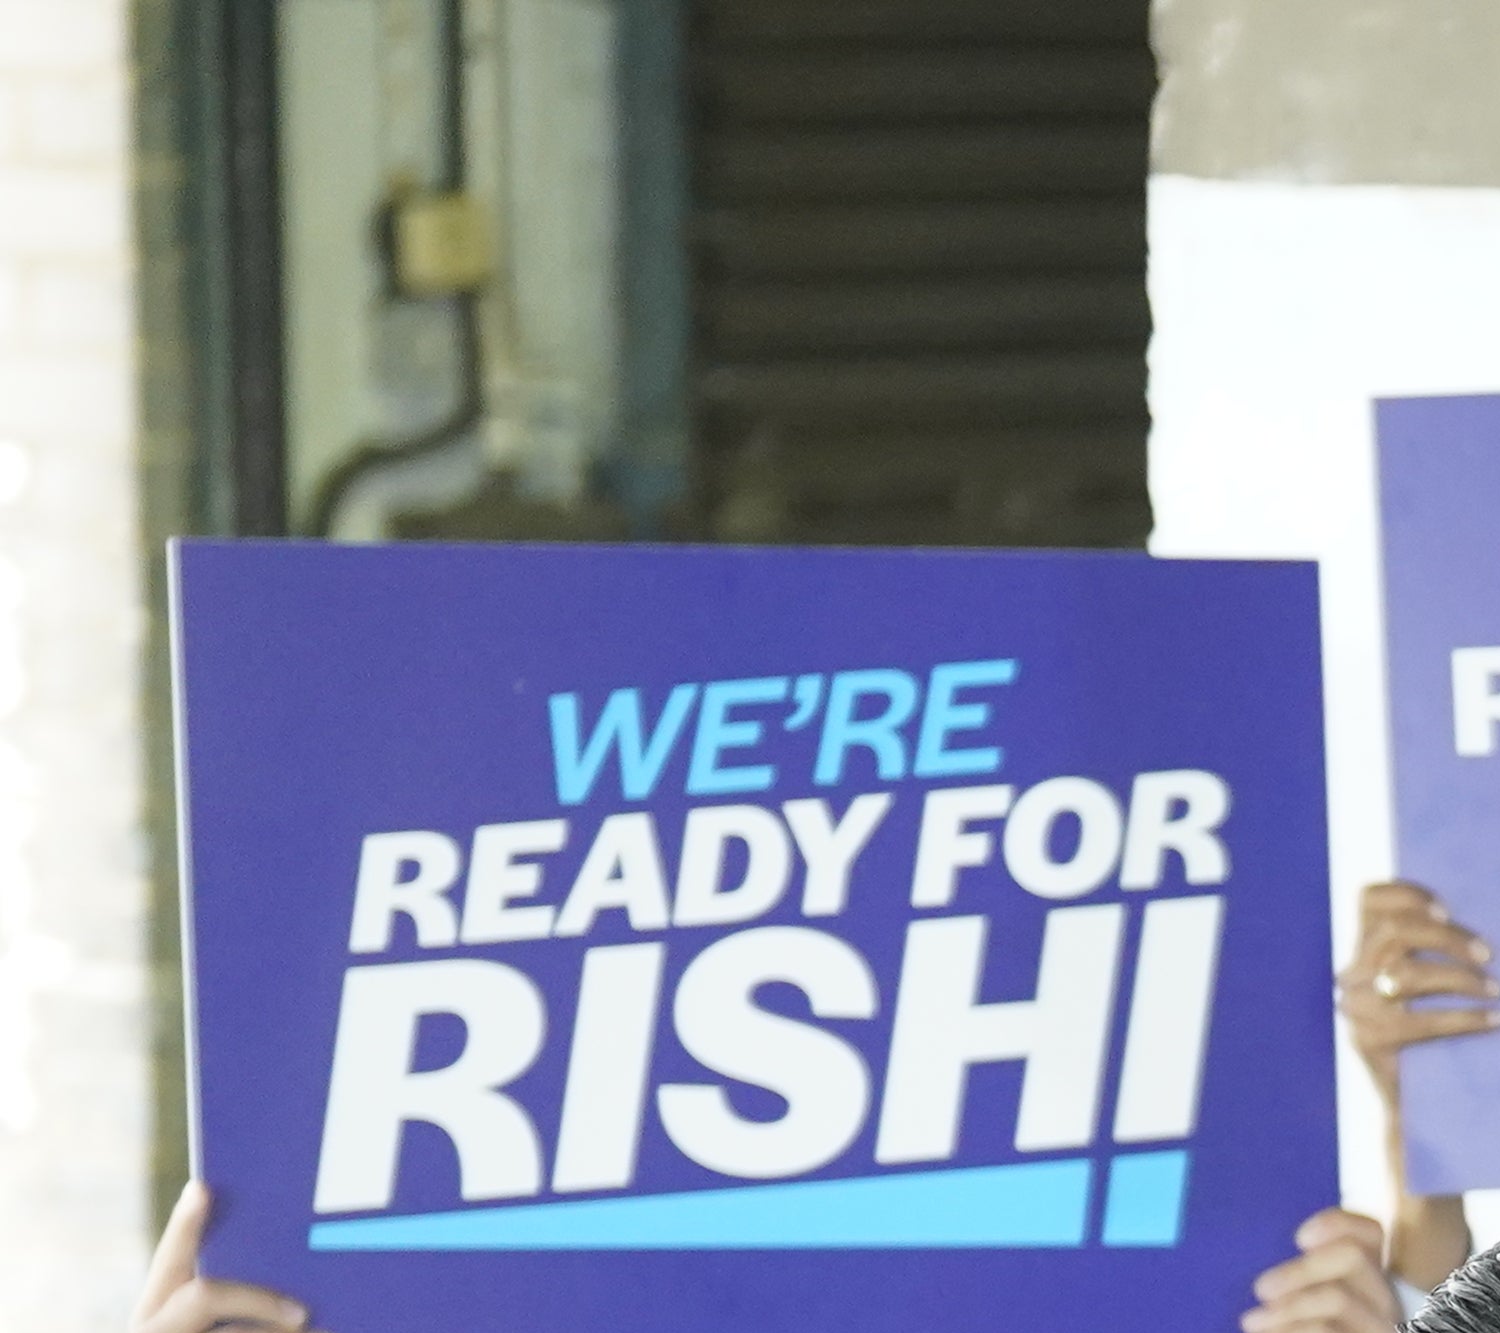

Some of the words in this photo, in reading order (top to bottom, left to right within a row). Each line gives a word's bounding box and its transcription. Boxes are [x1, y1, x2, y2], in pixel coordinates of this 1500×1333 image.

[547, 657, 1018, 807] WE'RE
[348, 792, 891, 954] READY
[909, 769, 1227, 908] FOR
[311, 895, 1223, 1214] RISHI
